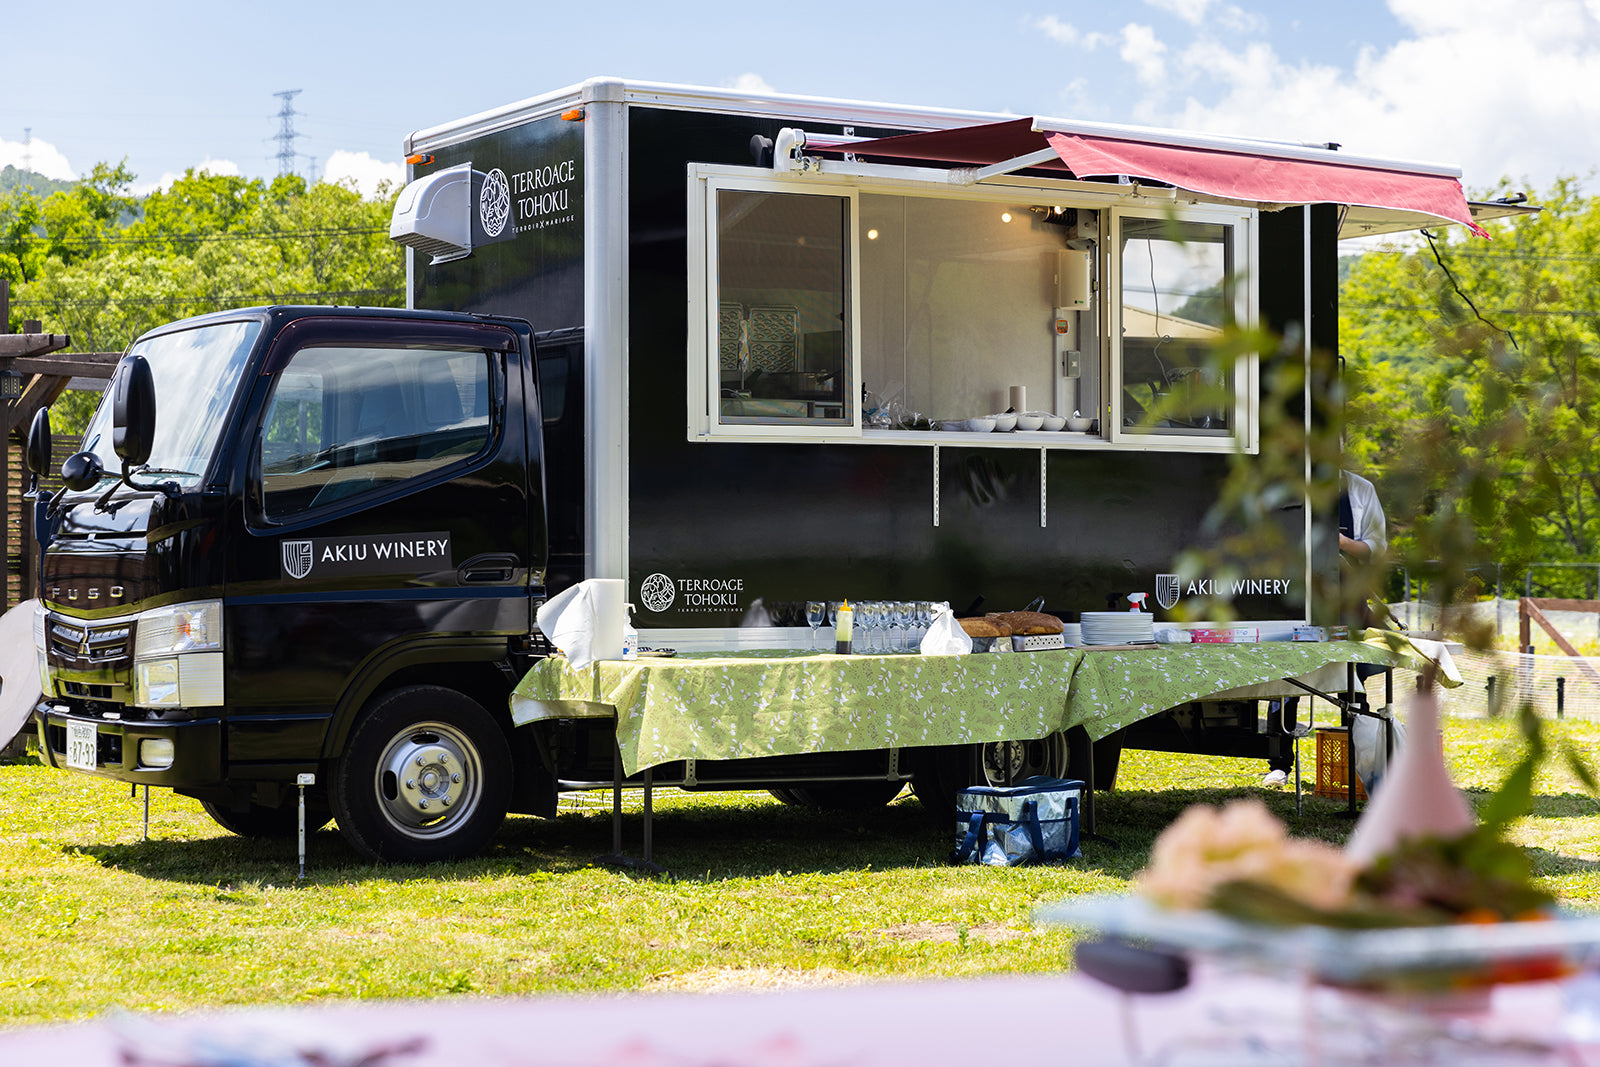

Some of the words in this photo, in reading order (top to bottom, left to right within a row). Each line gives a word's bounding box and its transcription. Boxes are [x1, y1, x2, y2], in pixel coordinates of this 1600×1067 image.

[511, 160, 576, 195] TERROAGE
[517, 188, 569, 220] TOHOKU
[321, 543, 368, 563] AKIU
[372, 539, 449, 560] WINERY
[52, 585, 124, 600] FUSO
[677, 578, 744, 591] TERROAGE
[1186, 579, 1225, 595] AKIU
[1230, 579, 1291, 595] WINERY
[683, 593, 737, 606] TOHOKU
